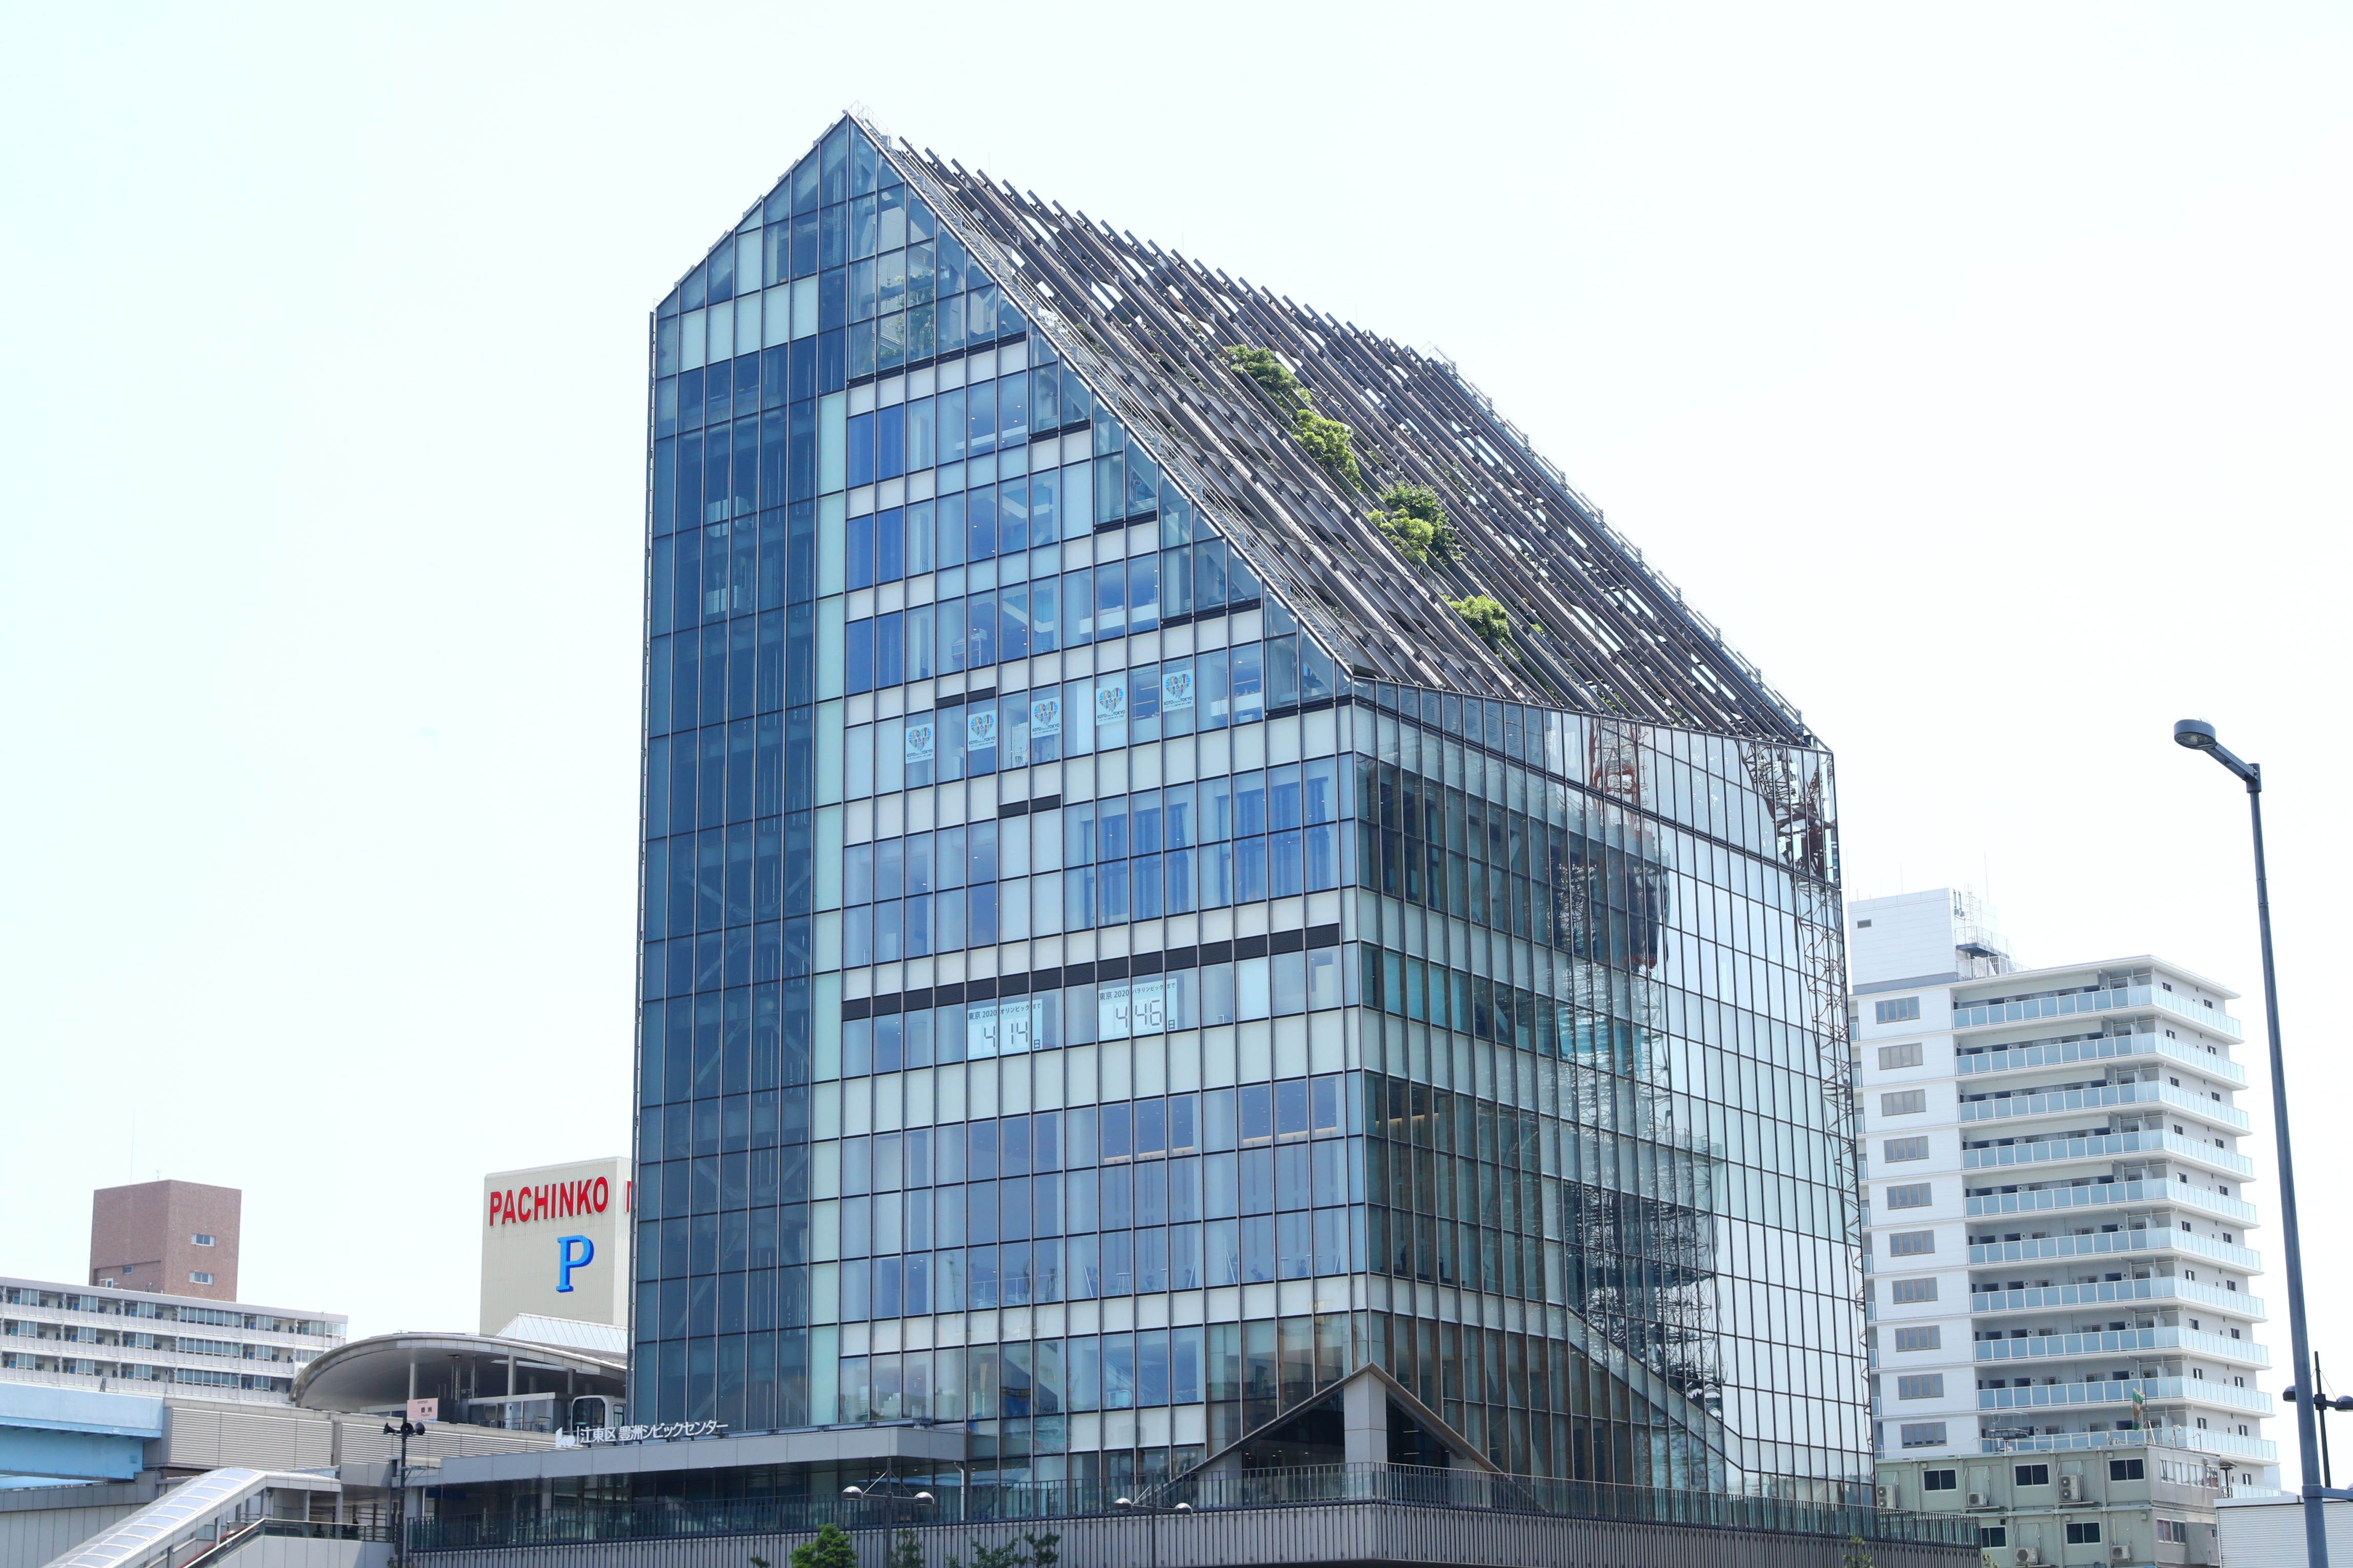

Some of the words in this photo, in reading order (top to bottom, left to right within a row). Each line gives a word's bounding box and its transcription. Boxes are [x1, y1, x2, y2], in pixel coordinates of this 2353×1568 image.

[1099, 991, 1112, 1001] 東京
[1114, 989, 1129, 998] 2020
[968, 1011, 980, 1021] 東京
[982, 1009, 997, 1018] 2020
[1169, 1020, 1175, 1030] 日
[1034, 1039, 1040, 1049] 日
[489, 1176, 609, 1226] PACHINKO
[556, 1235, 594, 1293] P
[580, 1427, 616, 1443] 江東区
[618, 1419, 728, 1441] 豊洲シビックセンター
